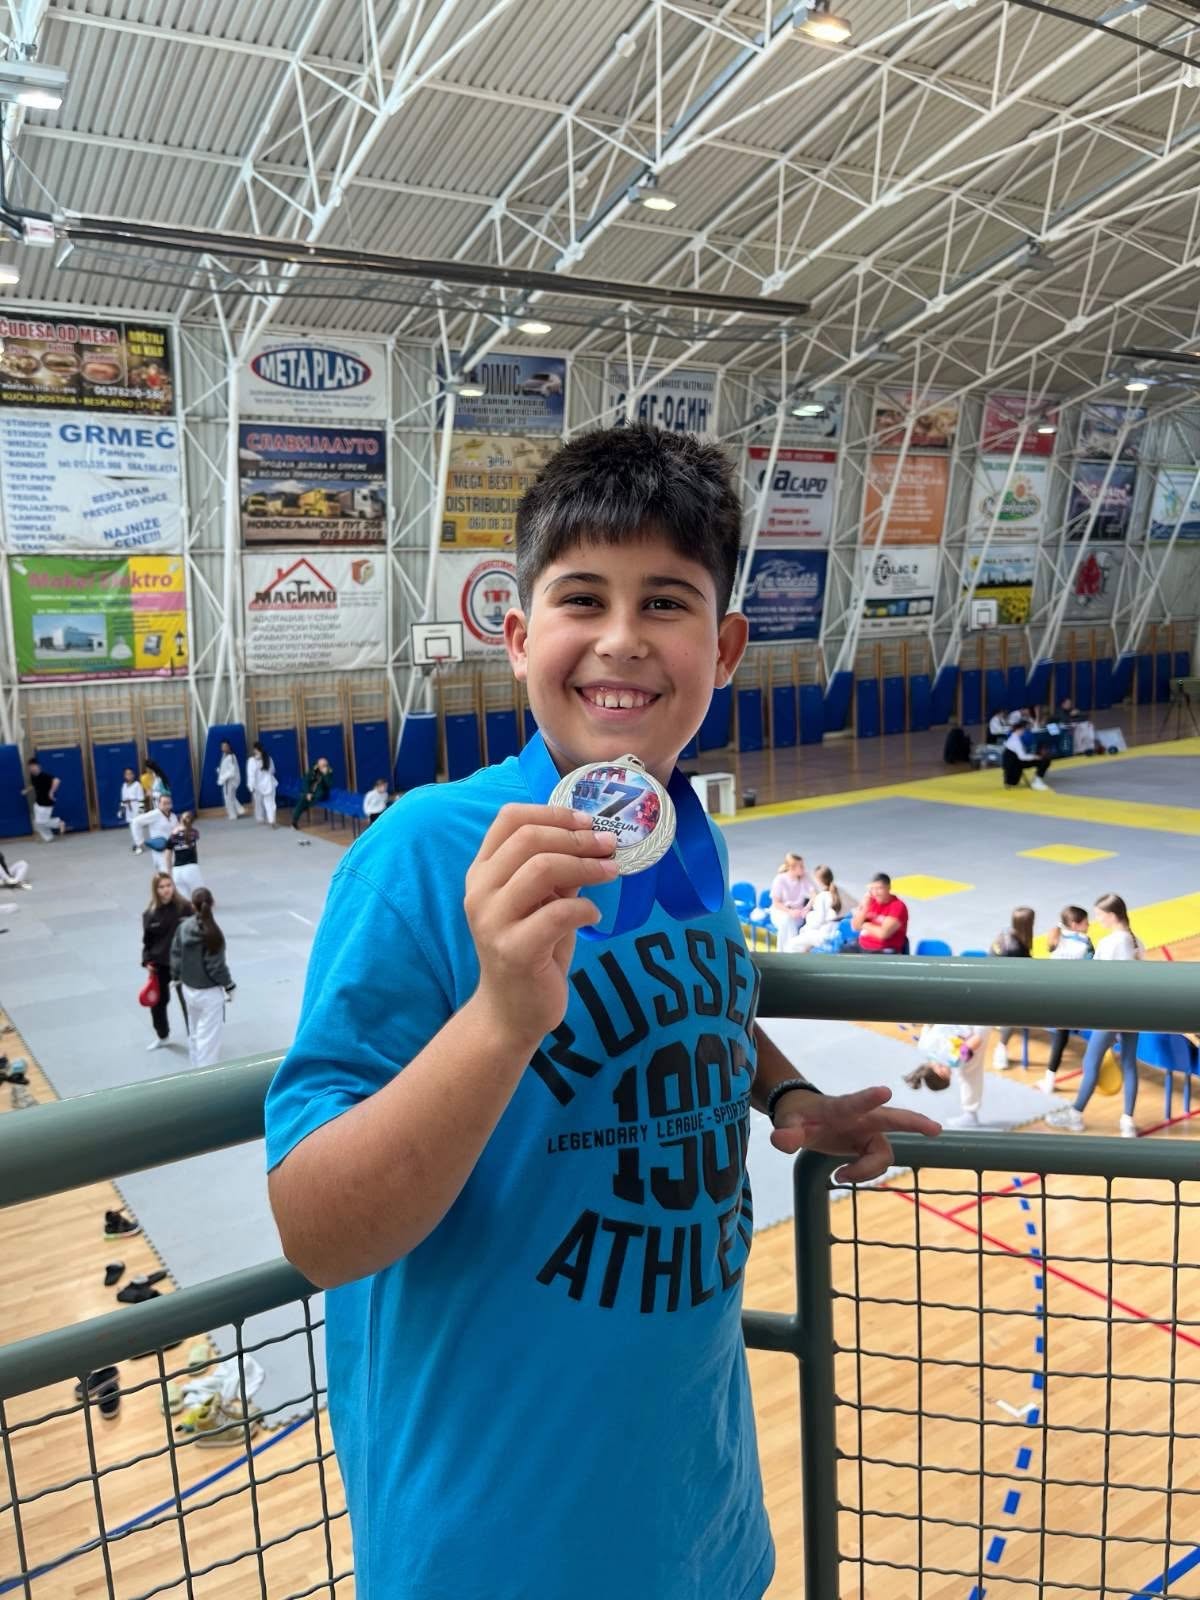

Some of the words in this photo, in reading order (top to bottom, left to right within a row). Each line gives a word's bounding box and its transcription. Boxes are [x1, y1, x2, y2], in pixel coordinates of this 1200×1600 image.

[57, 325, 78, 341] OD
[80, 328, 119, 345] MESA
[259, 349, 366, 389] METAPLAST
[59, 423, 176, 449] GRMEČ
[488, 475, 513, 490] BEST
[83, 503, 124, 519] PREVOZ
[126, 499, 139, 510] DO
[104, 517, 161, 541] NAJNIŽE
[247, 519, 339, 530] НОВОСЕЉАНСКИ
[342, 521, 361, 530] ПУТ
[255, 590, 337, 604] МАСИМО
[547, 1124, 648, 1154] LEGENDARY
